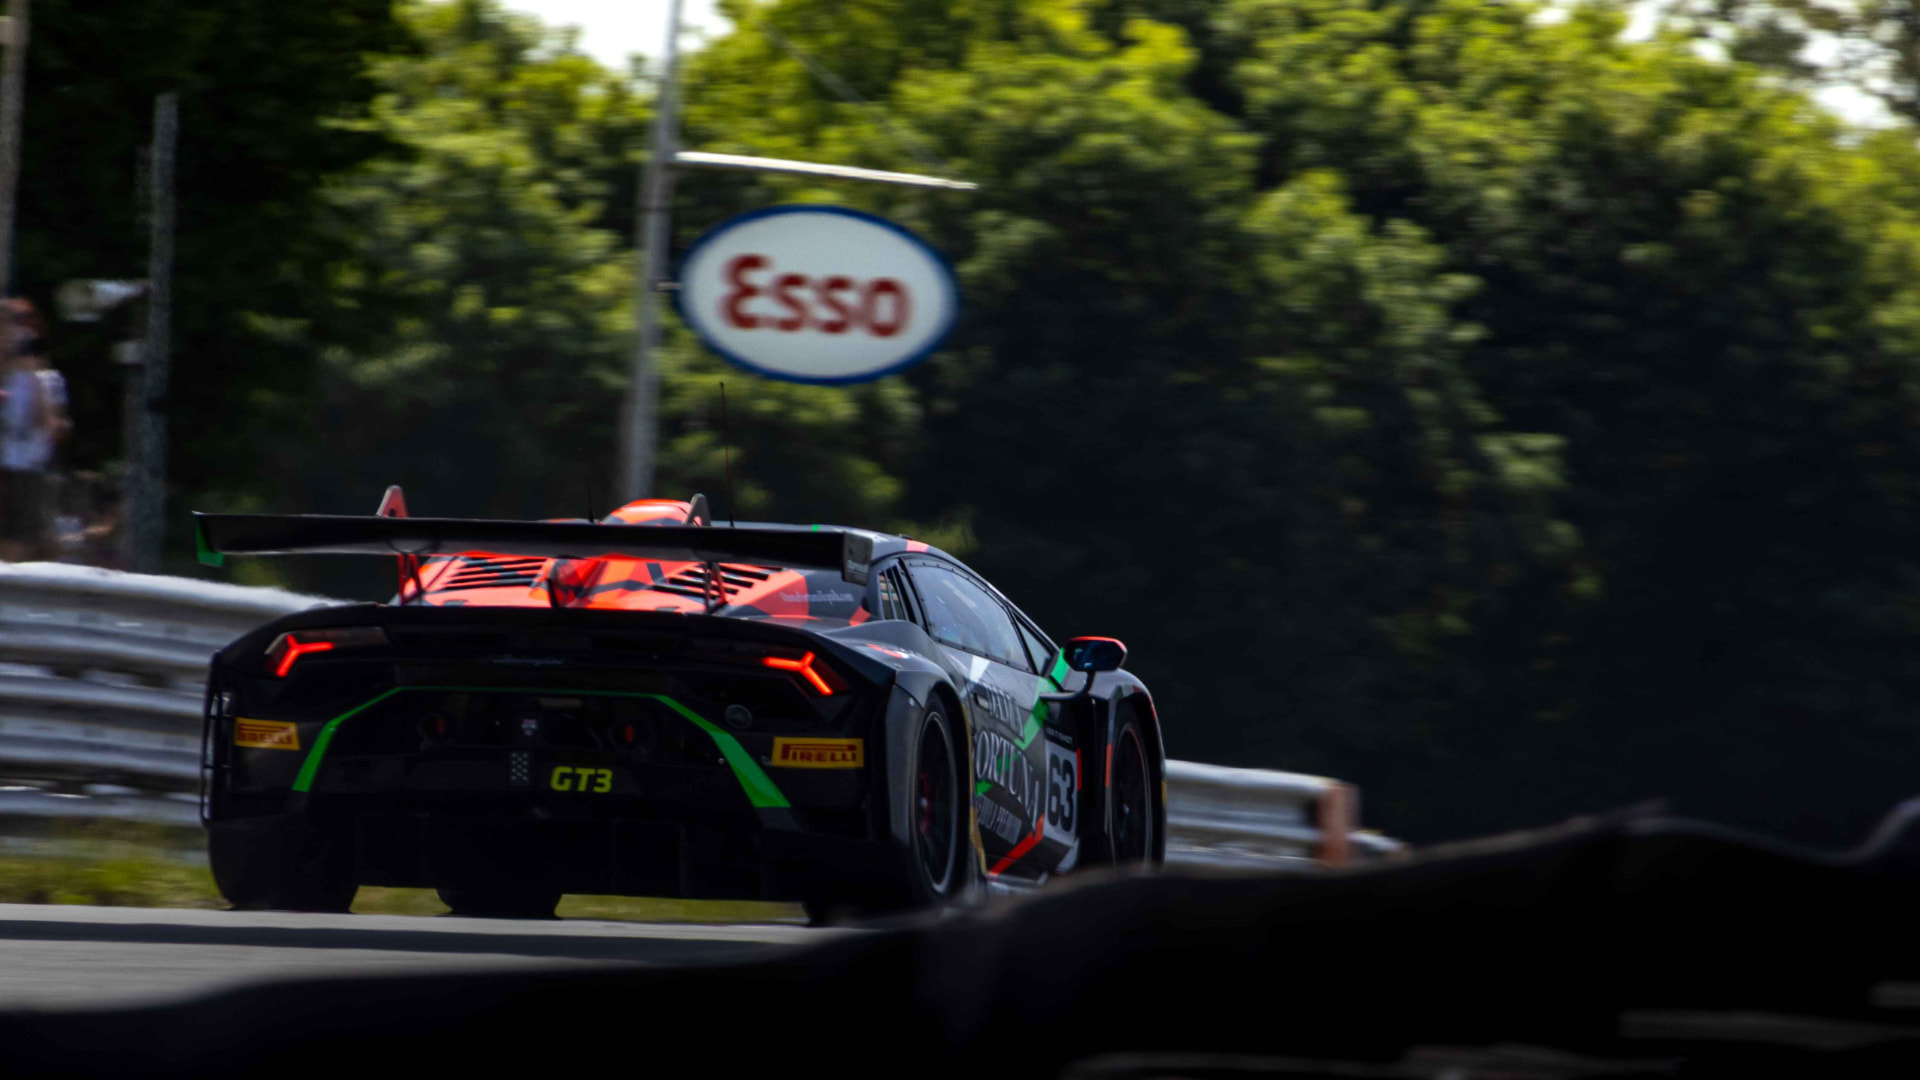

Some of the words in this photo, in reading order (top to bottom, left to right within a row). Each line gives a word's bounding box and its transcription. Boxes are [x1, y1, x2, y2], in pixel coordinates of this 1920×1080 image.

[720, 254, 912, 338] Esso
[550, 765, 613, 793] GT3
[781, 744, 857, 762] PIRELLI
[973, 729, 1040, 833] ORTUNA
[1048, 753, 1075, 833] 63
